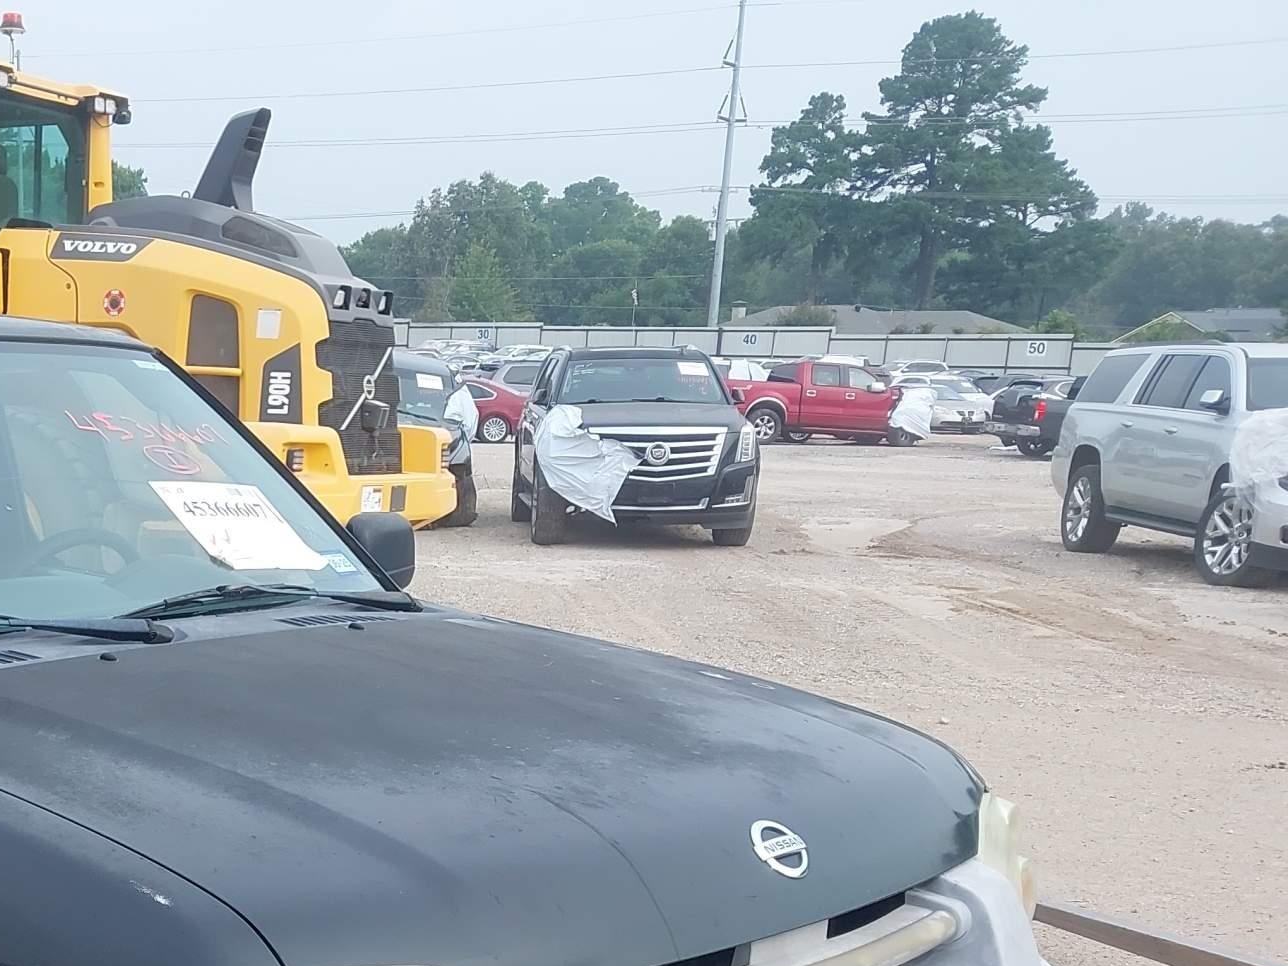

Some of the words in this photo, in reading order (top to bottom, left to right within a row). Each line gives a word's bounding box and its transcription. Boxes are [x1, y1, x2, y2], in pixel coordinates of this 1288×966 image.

[63, 240, 137, 254] VOLVO
[477, 329, 490, 340] 30
[743, 334, 757, 345] 40
[1028, 342, 1046, 354] 50
[267, 371, 292, 414] L90H
[182, 500, 268, 519] 45366607
[763, 836, 805, 855] NISSAN
